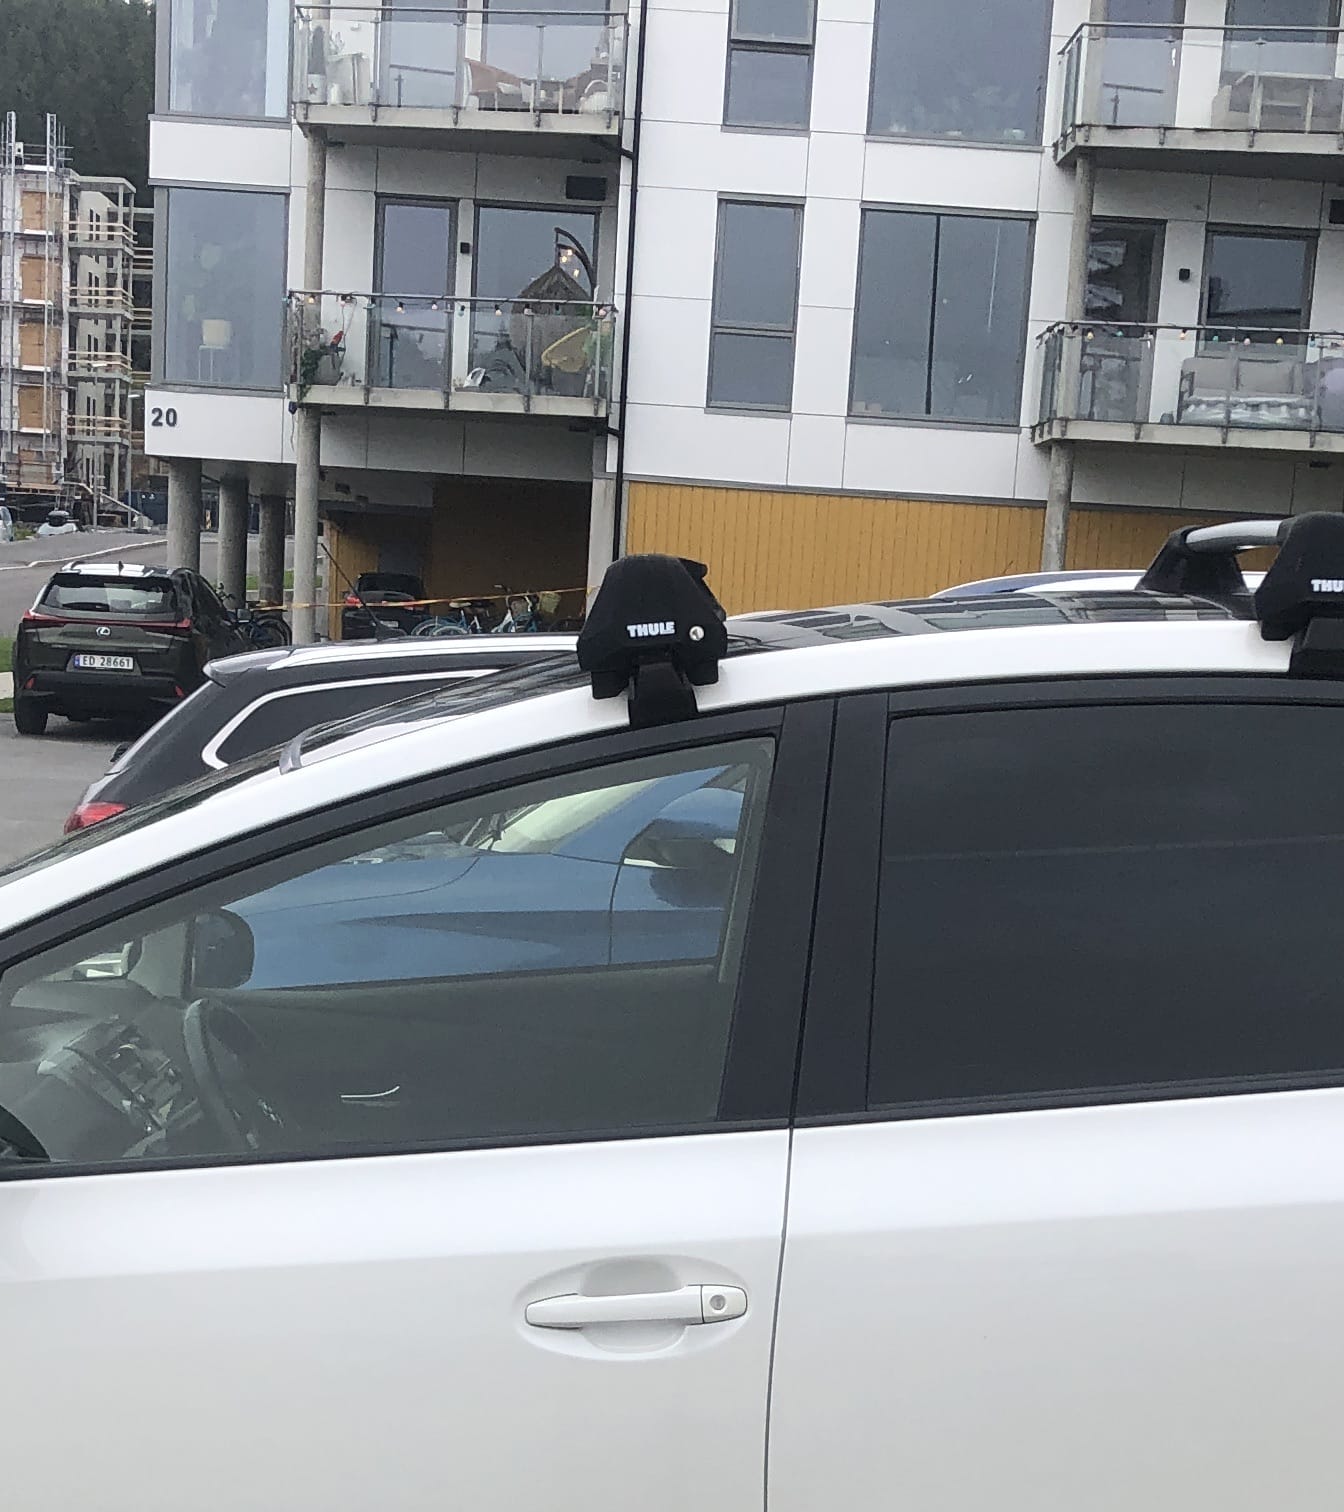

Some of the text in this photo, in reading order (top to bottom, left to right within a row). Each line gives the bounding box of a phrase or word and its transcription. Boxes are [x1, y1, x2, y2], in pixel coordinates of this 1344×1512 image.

[151, 407, 178, 427] 20
[626, 621, 676, 638] THULE
[82, 655, 131, 668] ED 28661
